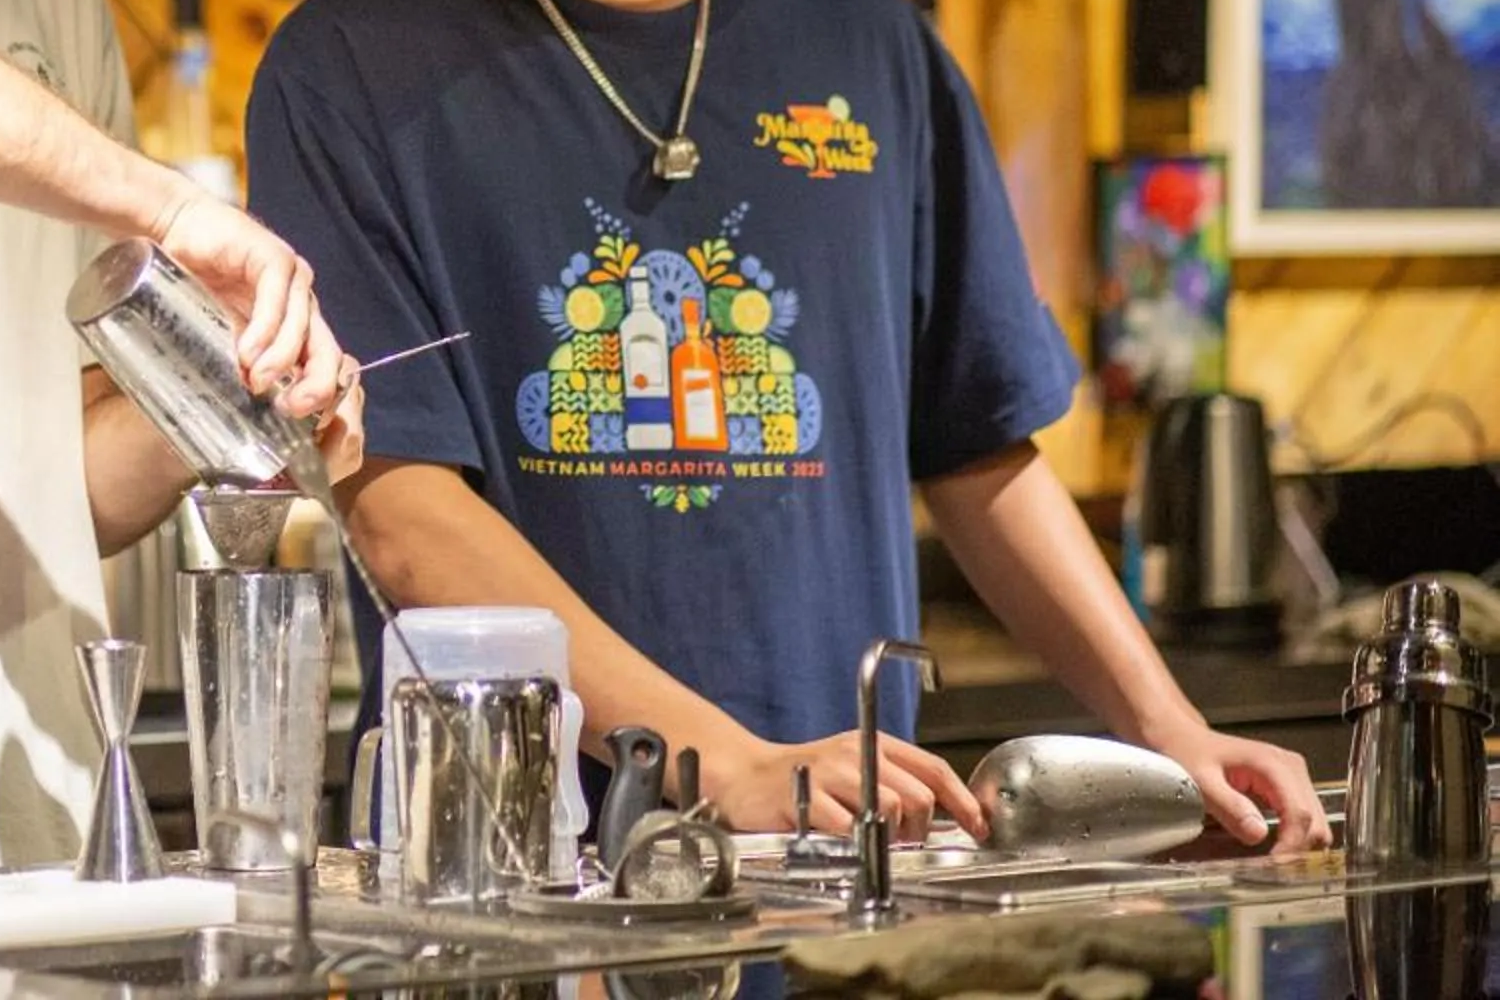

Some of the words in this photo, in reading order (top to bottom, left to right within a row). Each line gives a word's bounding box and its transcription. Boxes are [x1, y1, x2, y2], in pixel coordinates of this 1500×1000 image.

[518, 456, 604, 476] VIETNAM
[610, 460, 727, 477] MARGARITA
[732, 462, 787, 478] WEEK
